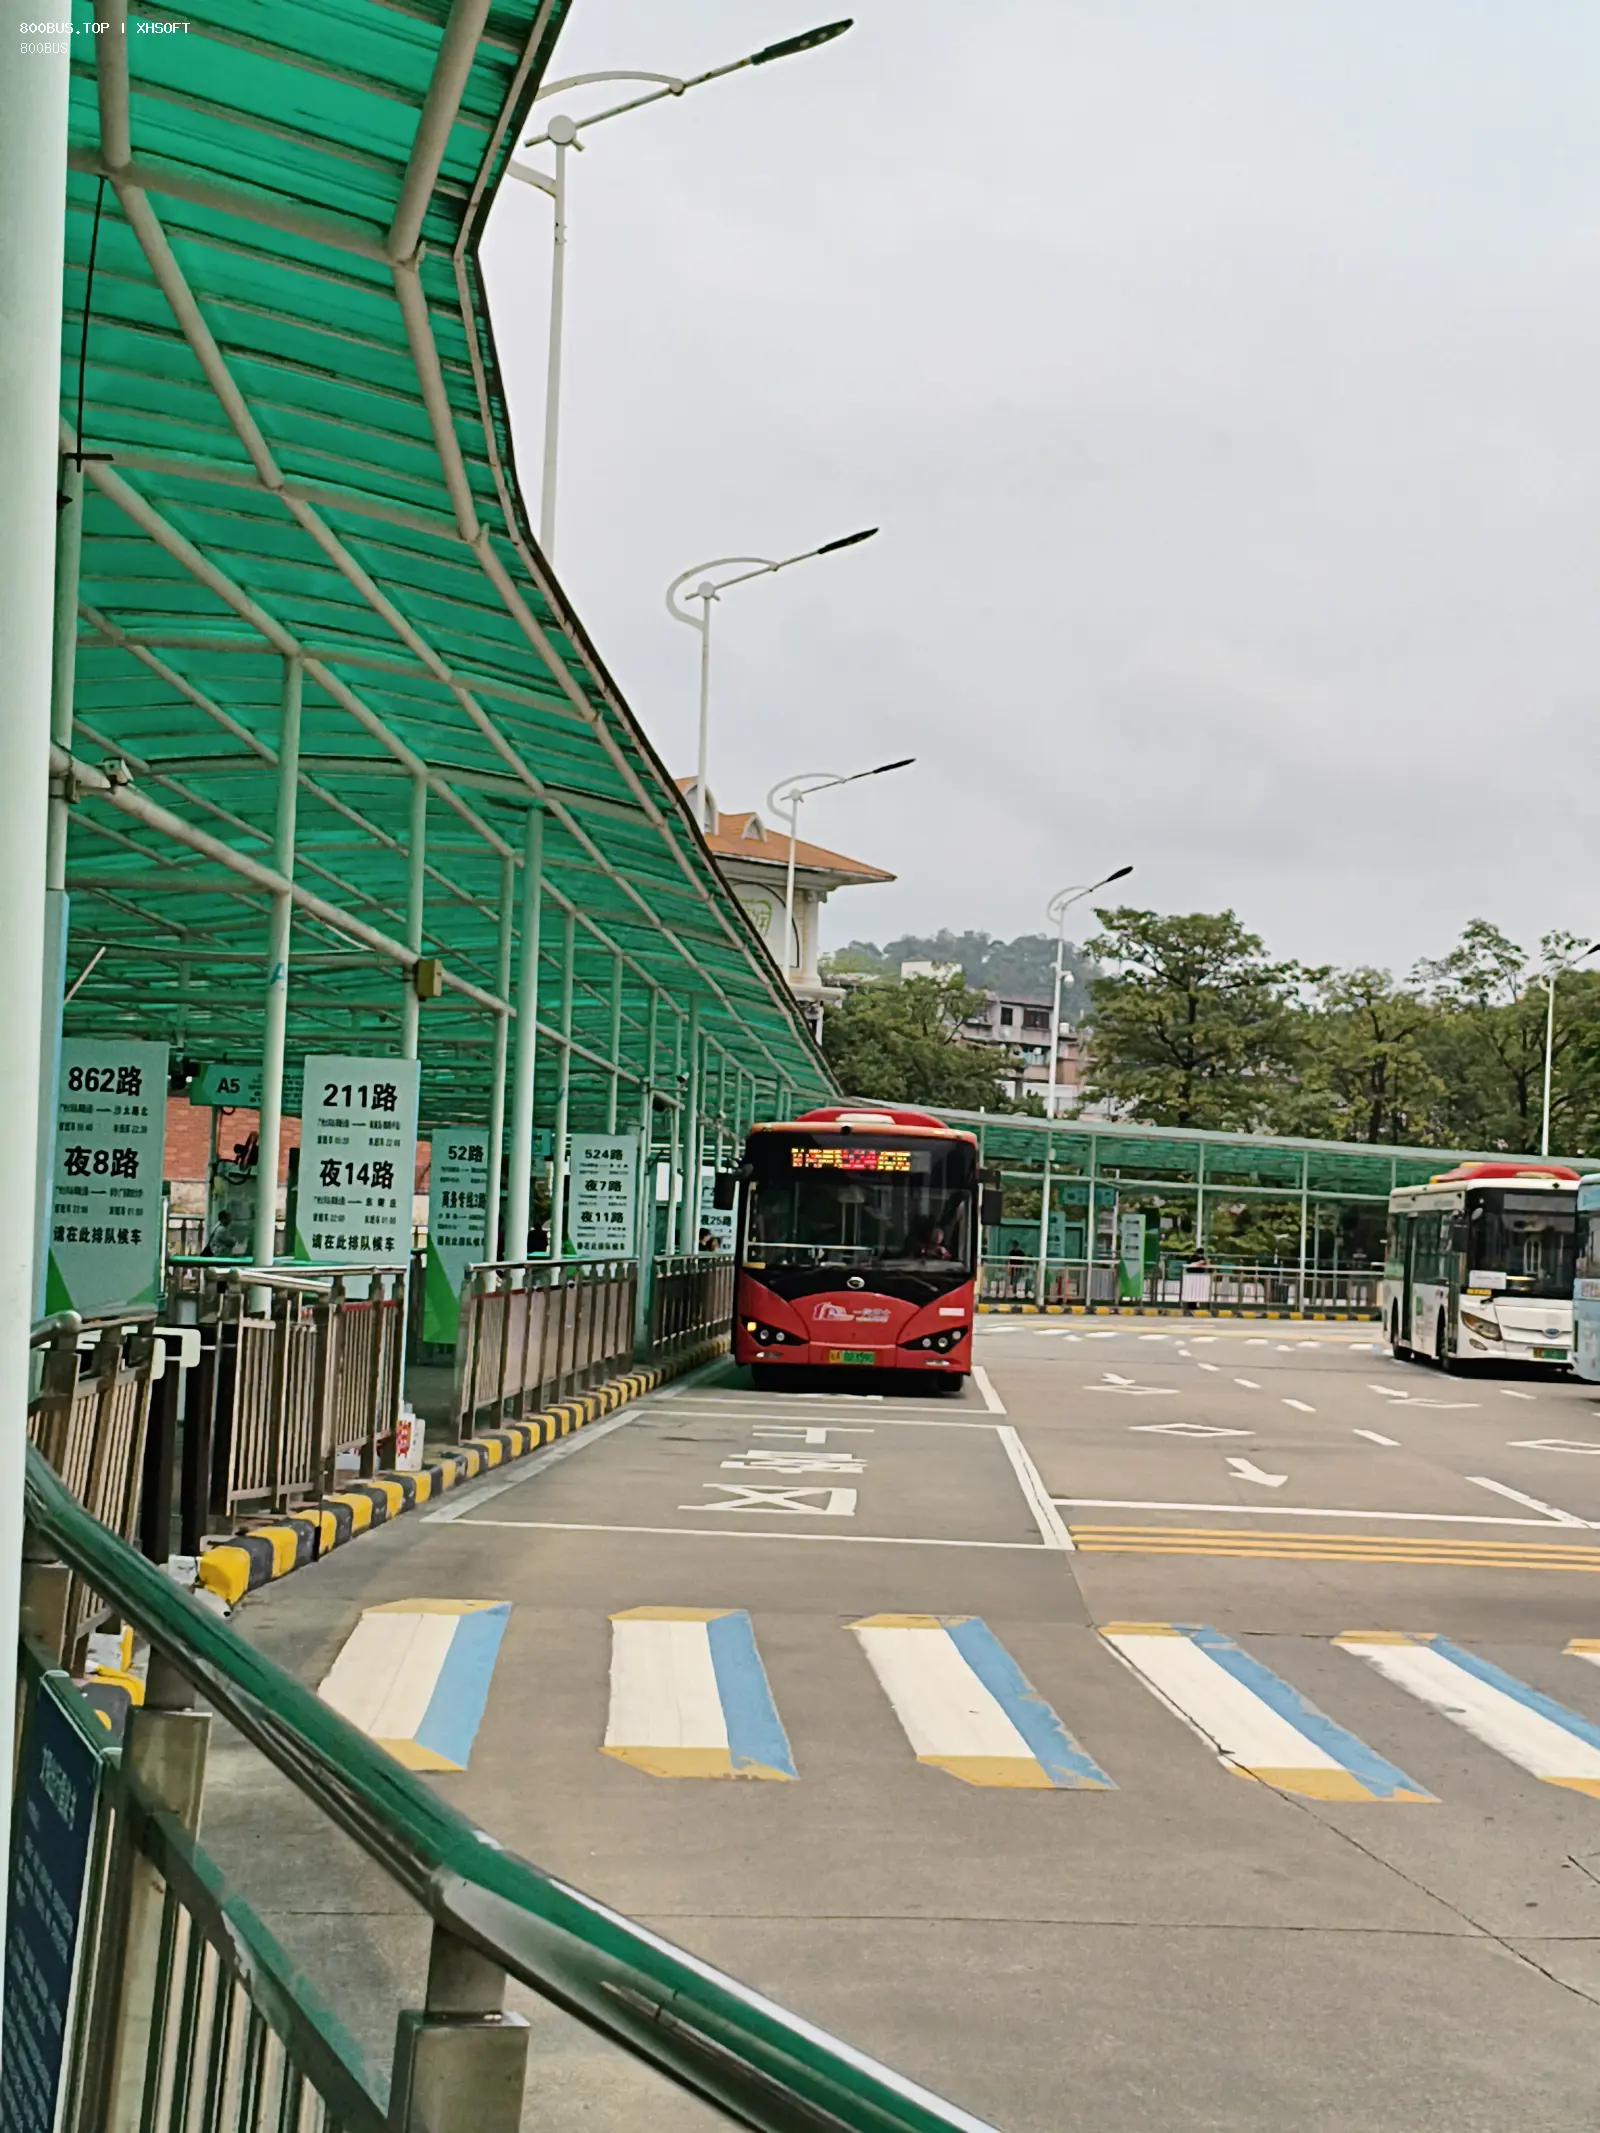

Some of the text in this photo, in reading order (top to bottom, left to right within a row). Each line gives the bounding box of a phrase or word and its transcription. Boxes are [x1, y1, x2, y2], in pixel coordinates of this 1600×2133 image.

[68, 1065, 143, 1097] 862路
[216, 1077, 240, 1094] A5
[322, 1083, 398, 1112] 211路
[64, 1146, 139, 1179] 夜8路
[448, 1144, 484, 1162] 52路
[584, 1148, 623, 1160] 524路
[320, 1158, 394, 1189] 夜14路
[584, 1180, 622, 1192] 夜7路
[580, 1211, 623, 1223] 夜11路
[53, 1225, 142, 1245] 请在此排队候车
[312, 1233, 396, 1252] 请在此排队候车
